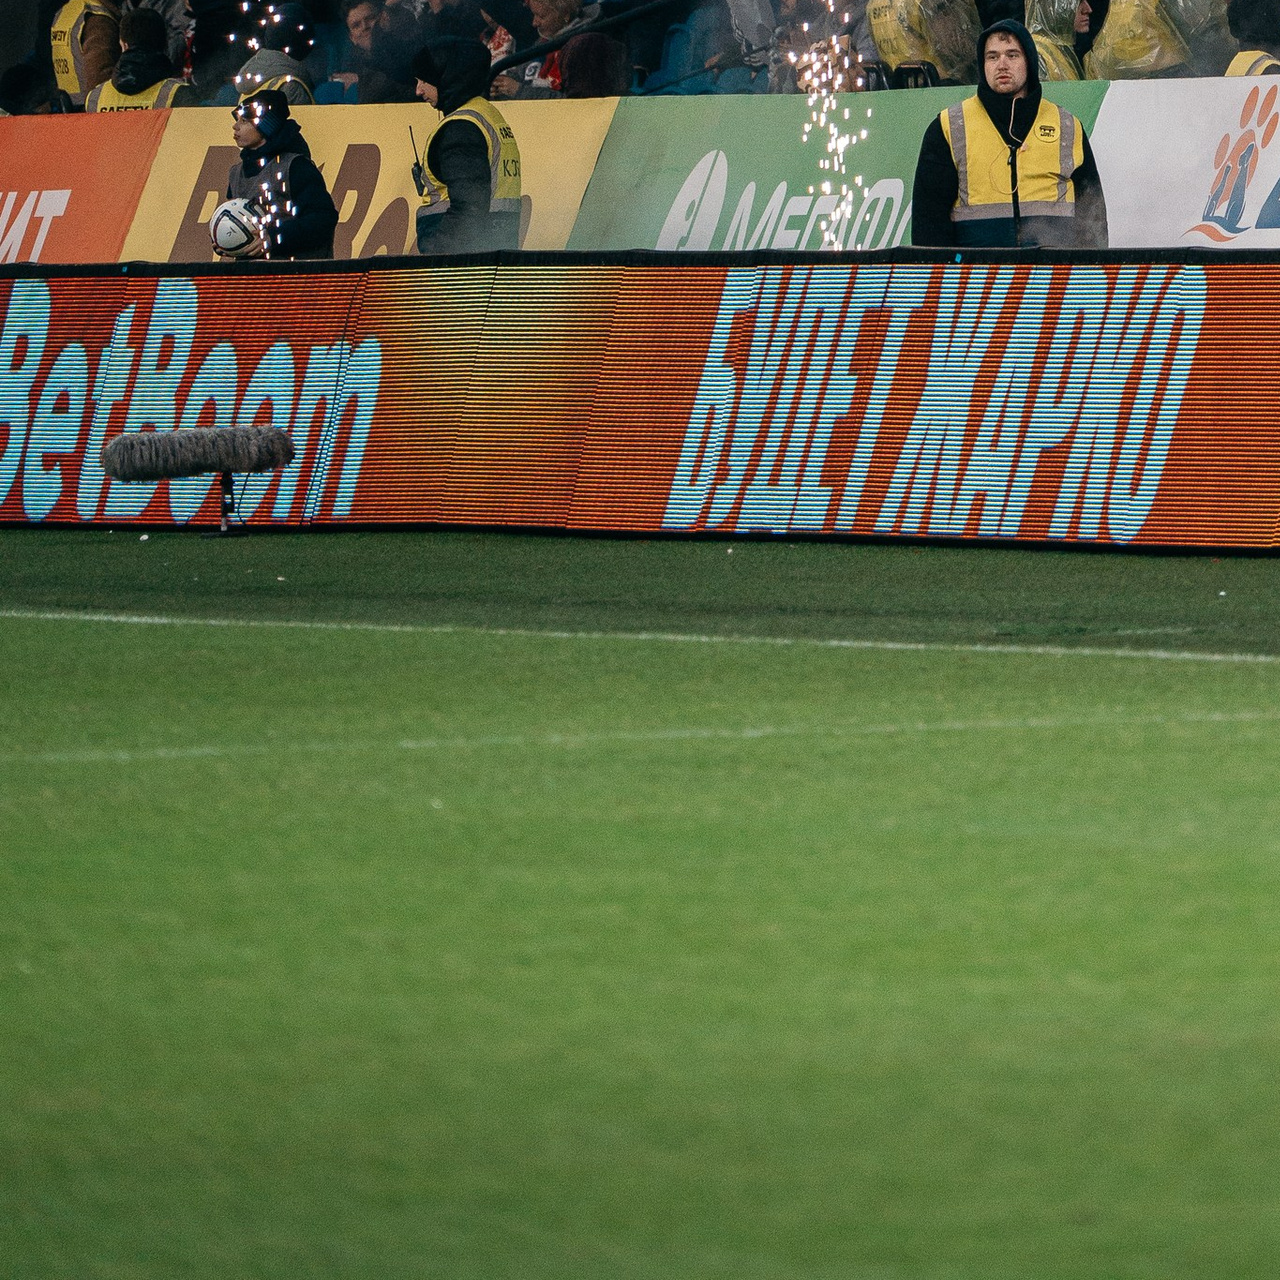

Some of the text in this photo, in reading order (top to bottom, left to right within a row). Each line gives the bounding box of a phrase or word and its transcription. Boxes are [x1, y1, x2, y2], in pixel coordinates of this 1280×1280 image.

[722, 177, 912, 252] МЕГАФ
[663, 263, 1208, 545] БУДЕТ ЖАРКО
